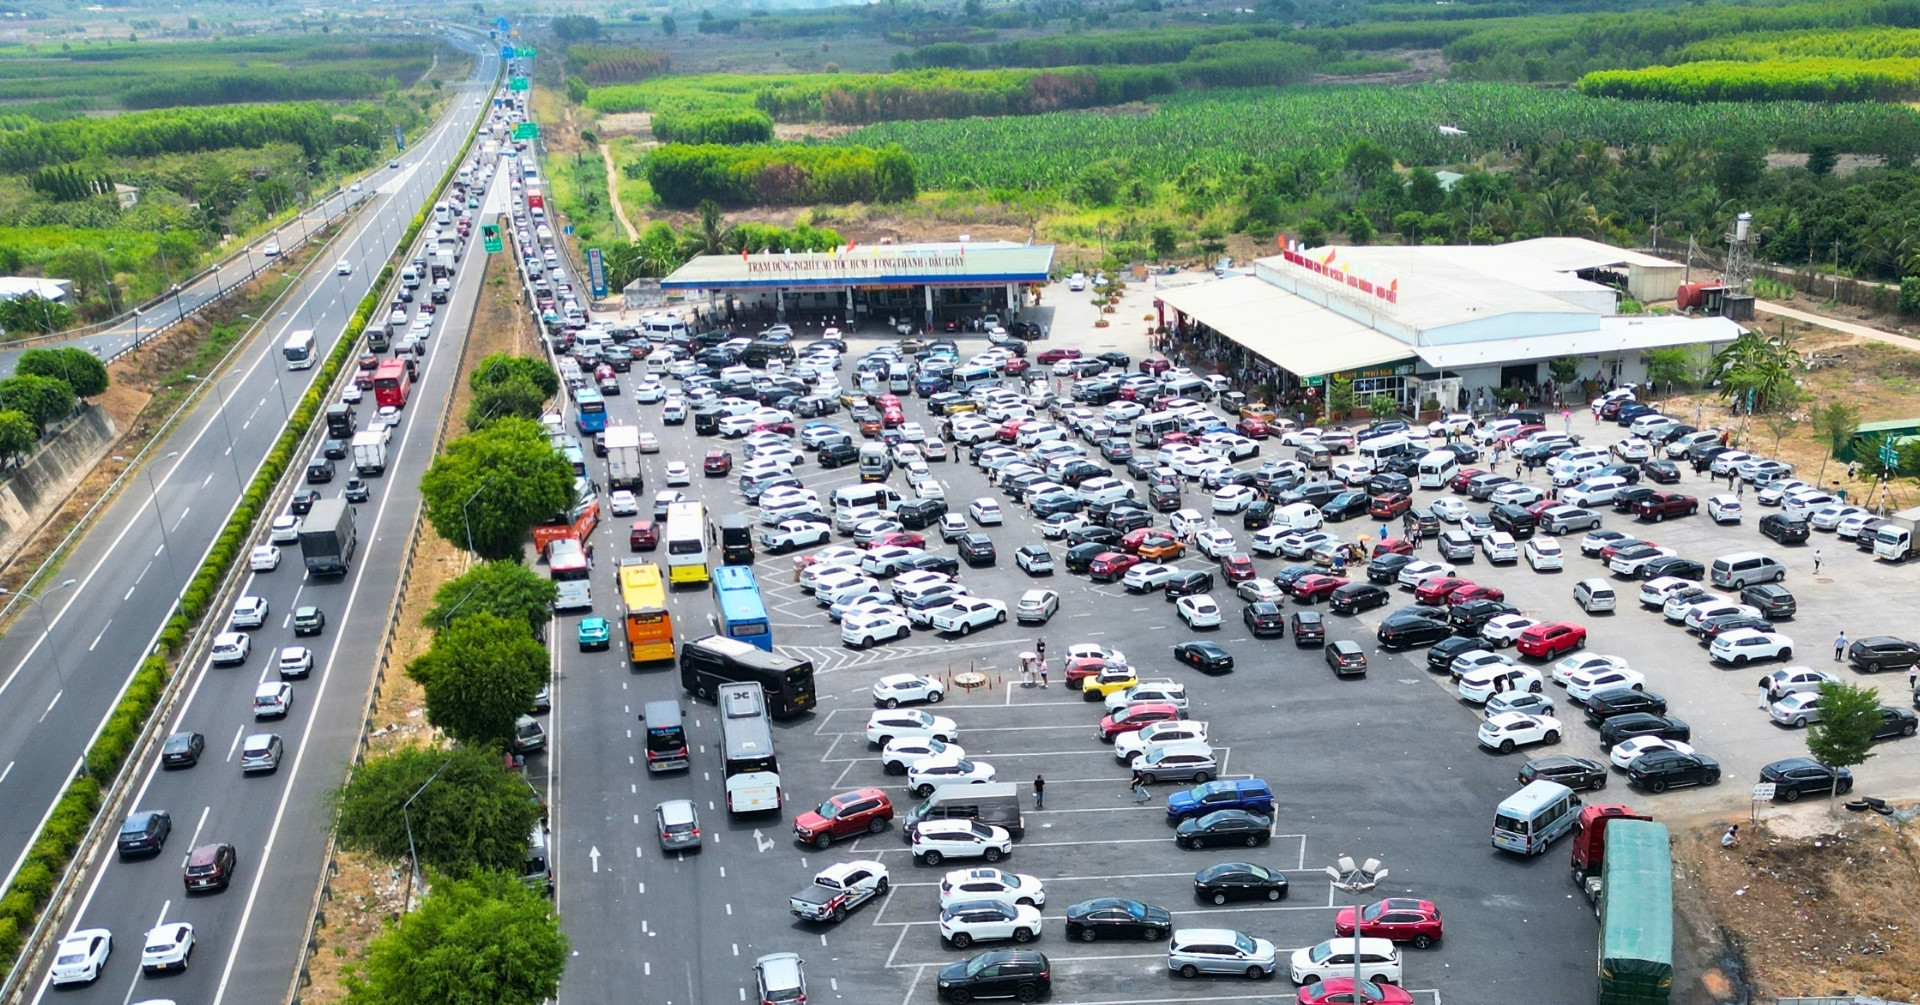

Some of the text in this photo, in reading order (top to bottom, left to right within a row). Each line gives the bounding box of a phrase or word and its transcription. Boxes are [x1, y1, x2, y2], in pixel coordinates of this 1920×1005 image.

[748, 261, 771, 273] TRẠM
[816, 259, 832, 270] CAO
[833, 255, 847, 269] TỐC
[850, 258, 868, 269] HCM
[874, 258, 896, 269] LONG
[897, 255, 924, 268] THÀNH
